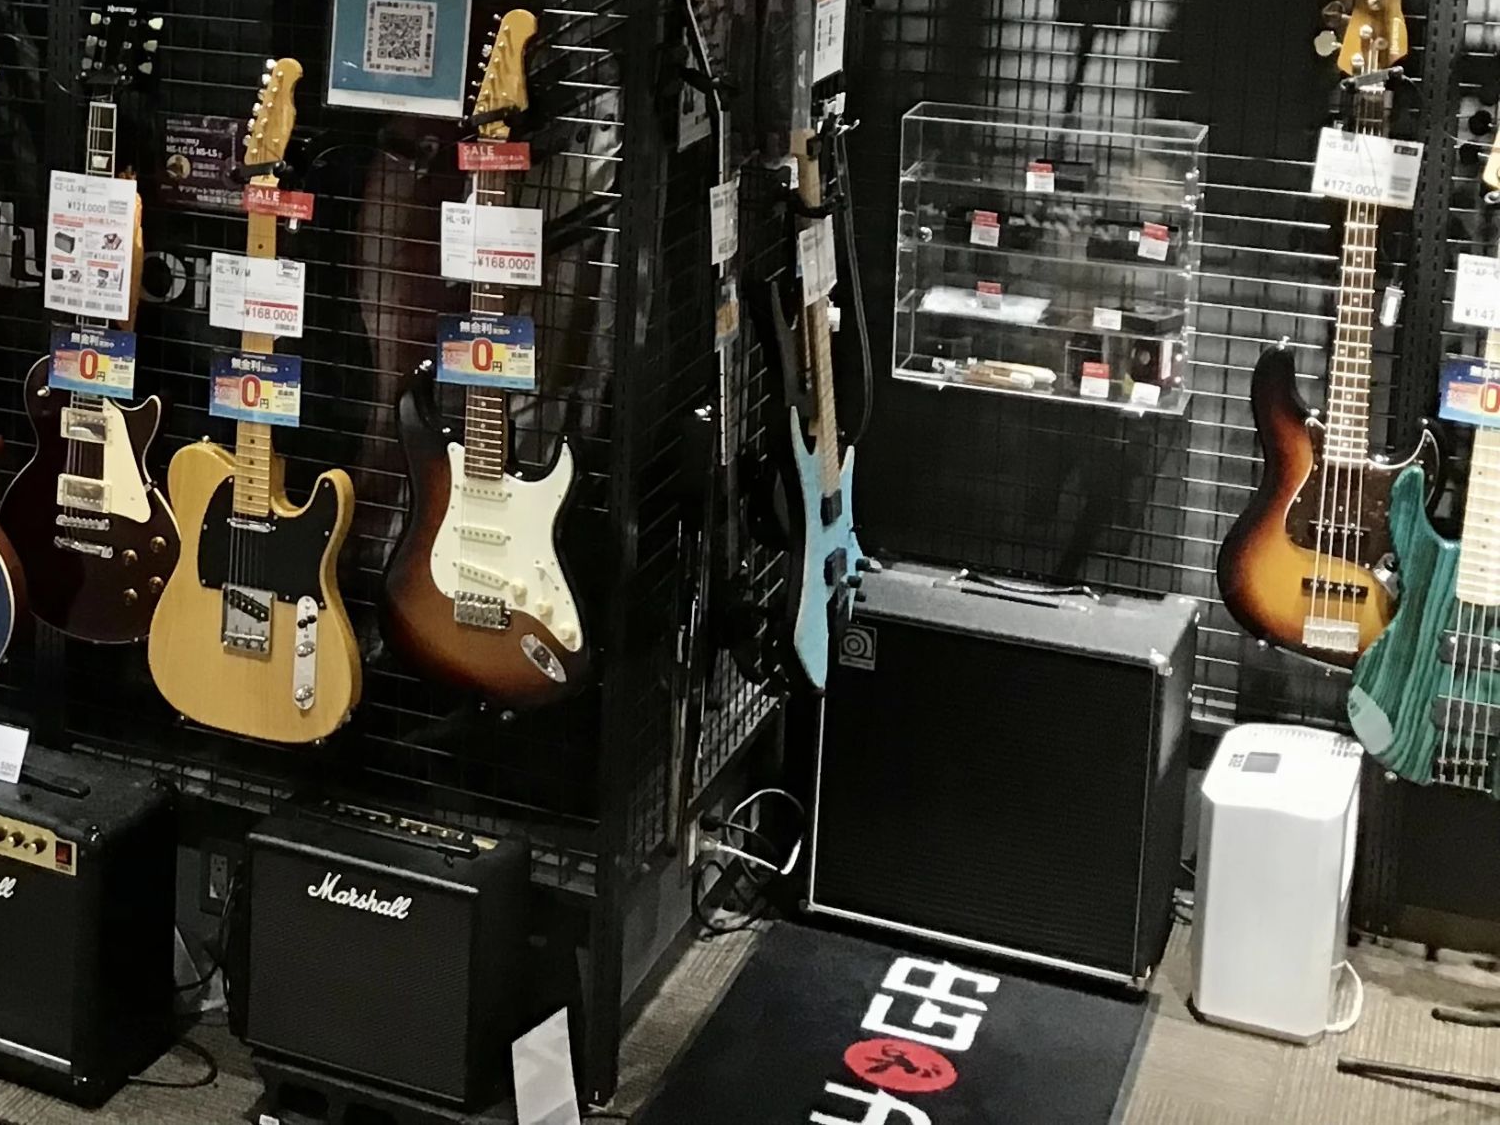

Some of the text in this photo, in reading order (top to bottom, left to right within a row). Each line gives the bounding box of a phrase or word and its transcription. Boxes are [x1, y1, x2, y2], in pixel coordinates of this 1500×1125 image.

[462, 144, 495, 156] SALE
[248, 189, 280, 203] SALE
[307, 871, 413, 920] Marshall
